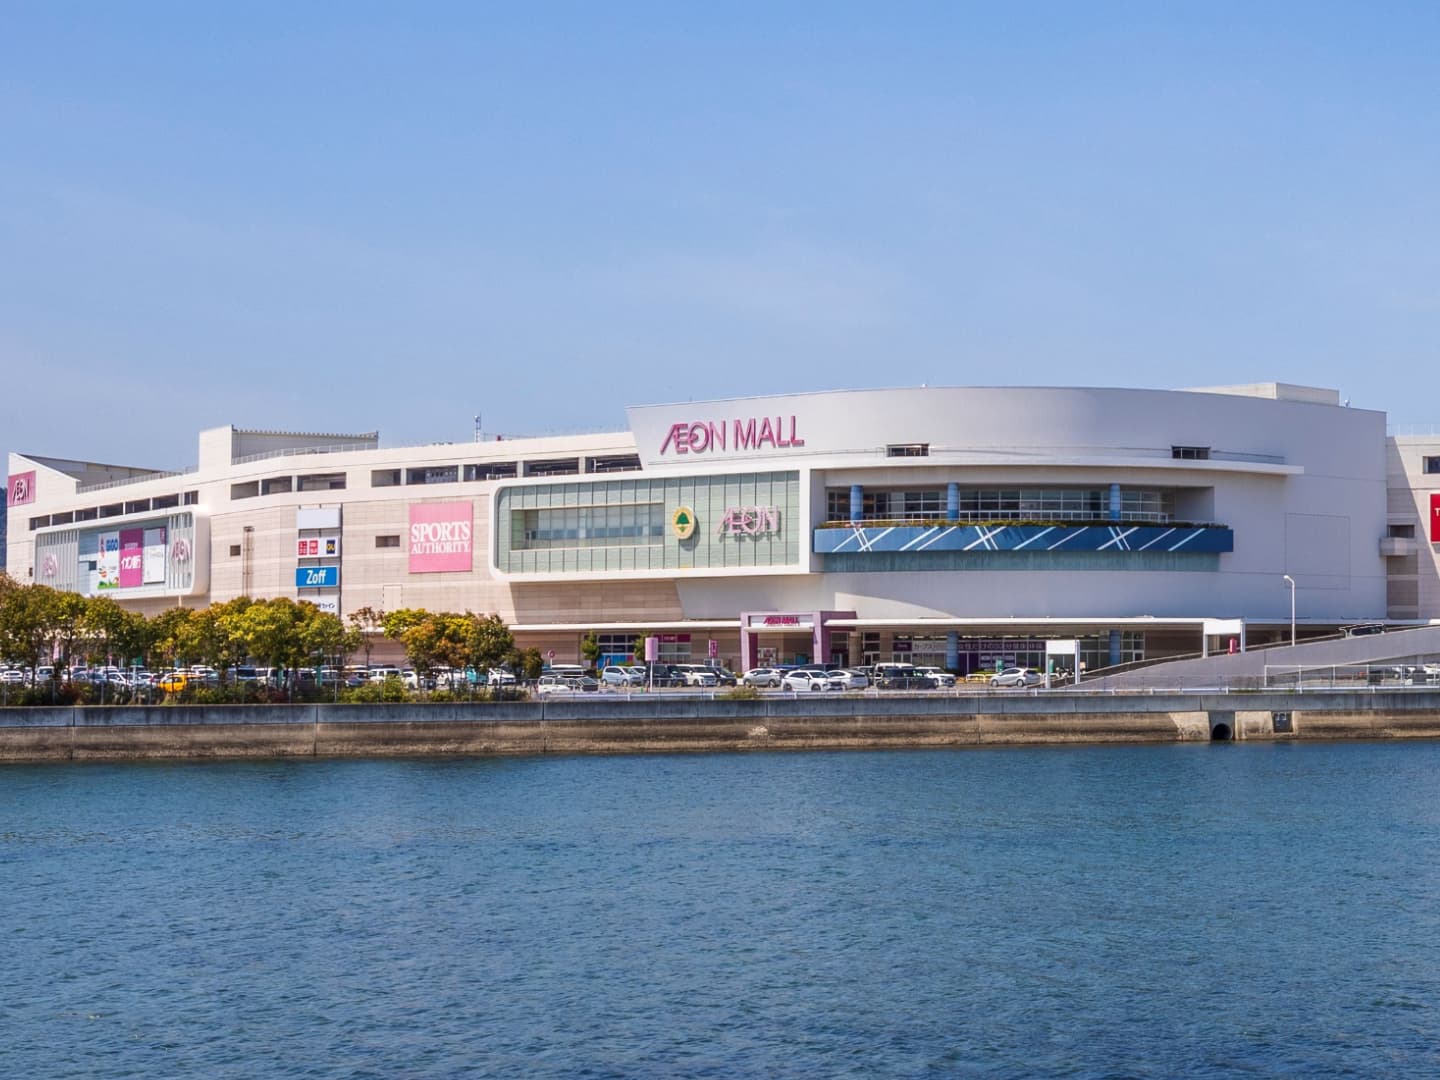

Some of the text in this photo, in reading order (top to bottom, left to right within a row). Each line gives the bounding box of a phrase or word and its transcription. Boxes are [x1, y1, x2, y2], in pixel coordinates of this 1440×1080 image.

[733, 415, 805, 450] MALL
[411, 521, 471, 542] SPORTS
[306, 569, 327, 584] Zoff
